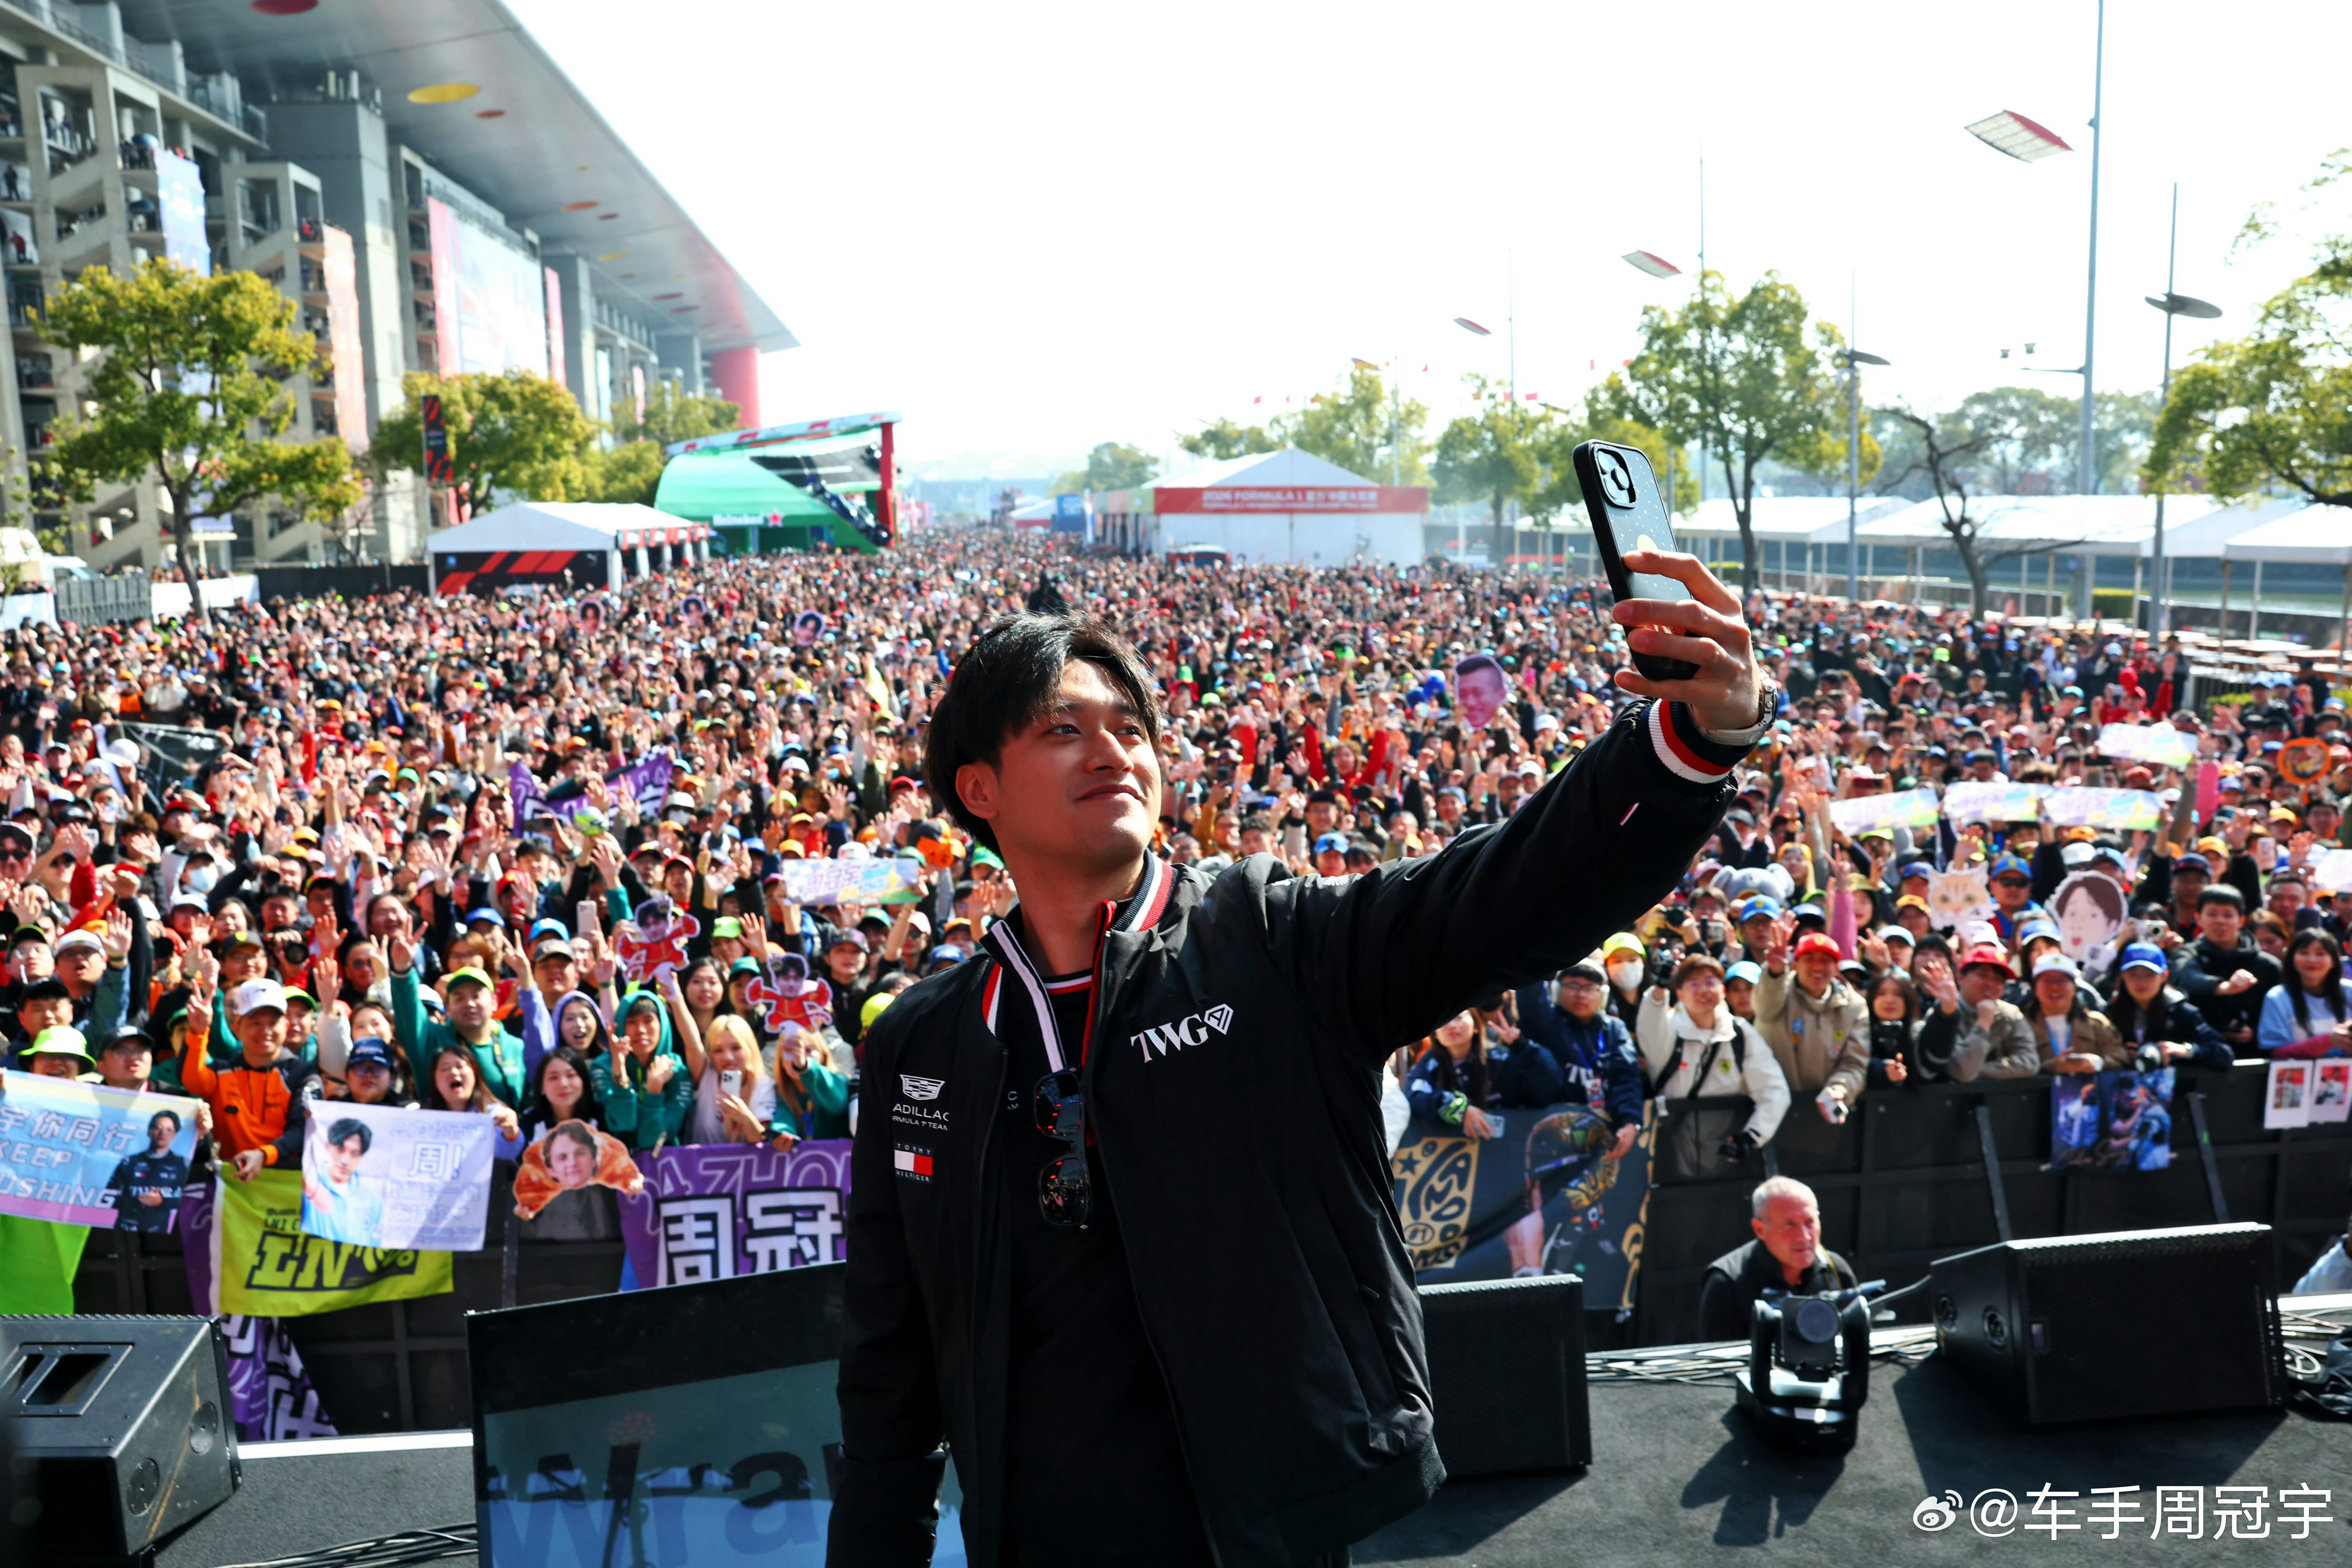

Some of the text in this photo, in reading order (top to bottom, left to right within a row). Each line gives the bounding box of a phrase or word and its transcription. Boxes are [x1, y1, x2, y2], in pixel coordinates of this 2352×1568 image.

[1130, 1013, 1209, 1063] TWG
[892, 1103, 949, 1122] ADILLAC
[892, 1116, 920, 1126] RMULA
[897, 1143, 931, 1155] TOMMY
[699, 1150, 851, 1222] ZHO
[896, 1170, 930, 1182] HILFIGER
[0, 1173, 123, 1209] USHING
[487, 1442, 843, 1568] Wra
